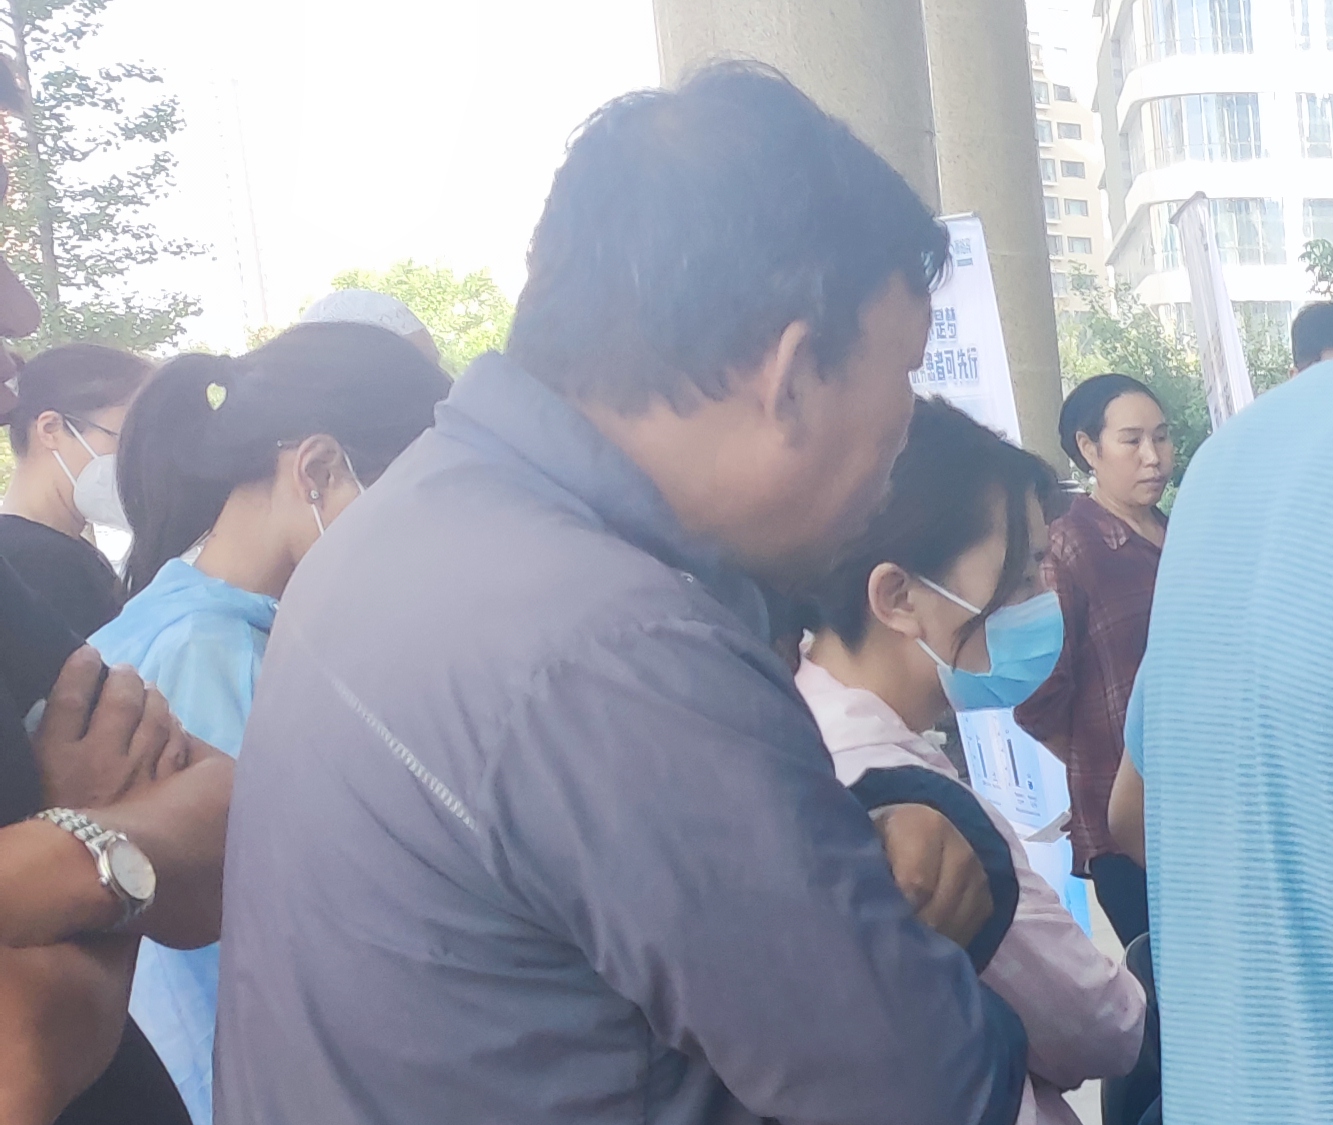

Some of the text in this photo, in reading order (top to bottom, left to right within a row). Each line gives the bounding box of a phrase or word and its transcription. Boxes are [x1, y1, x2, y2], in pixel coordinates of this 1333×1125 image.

[928, 307, 957, 341] 是梦
[911, 346, 979, 384] 患者可先行
